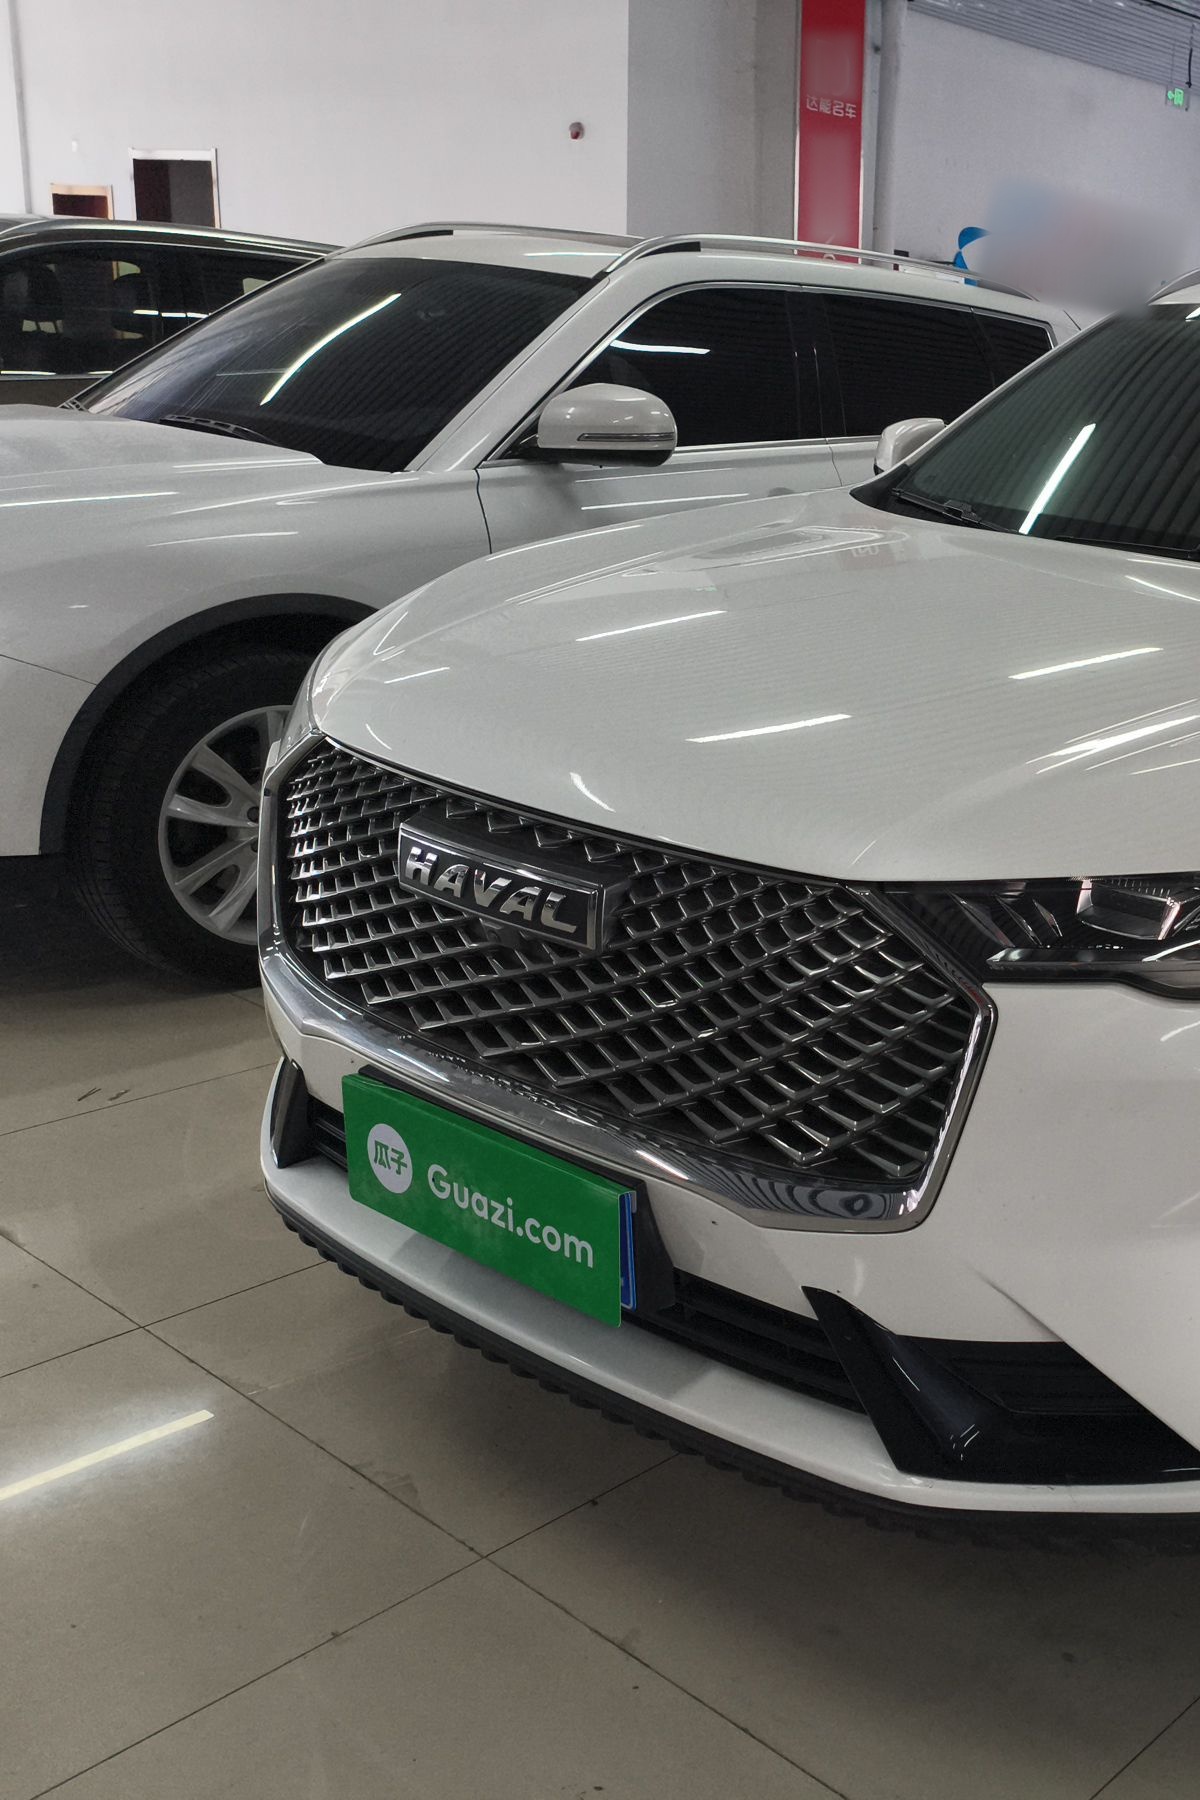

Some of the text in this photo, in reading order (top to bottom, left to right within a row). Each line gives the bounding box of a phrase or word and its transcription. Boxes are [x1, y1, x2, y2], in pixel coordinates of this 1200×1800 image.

[405, 846, 577, 934] HAVAL
[374, 1139, 408, 1176] 瓜子
[427, 1163, 594, 1269] Guazi.com
